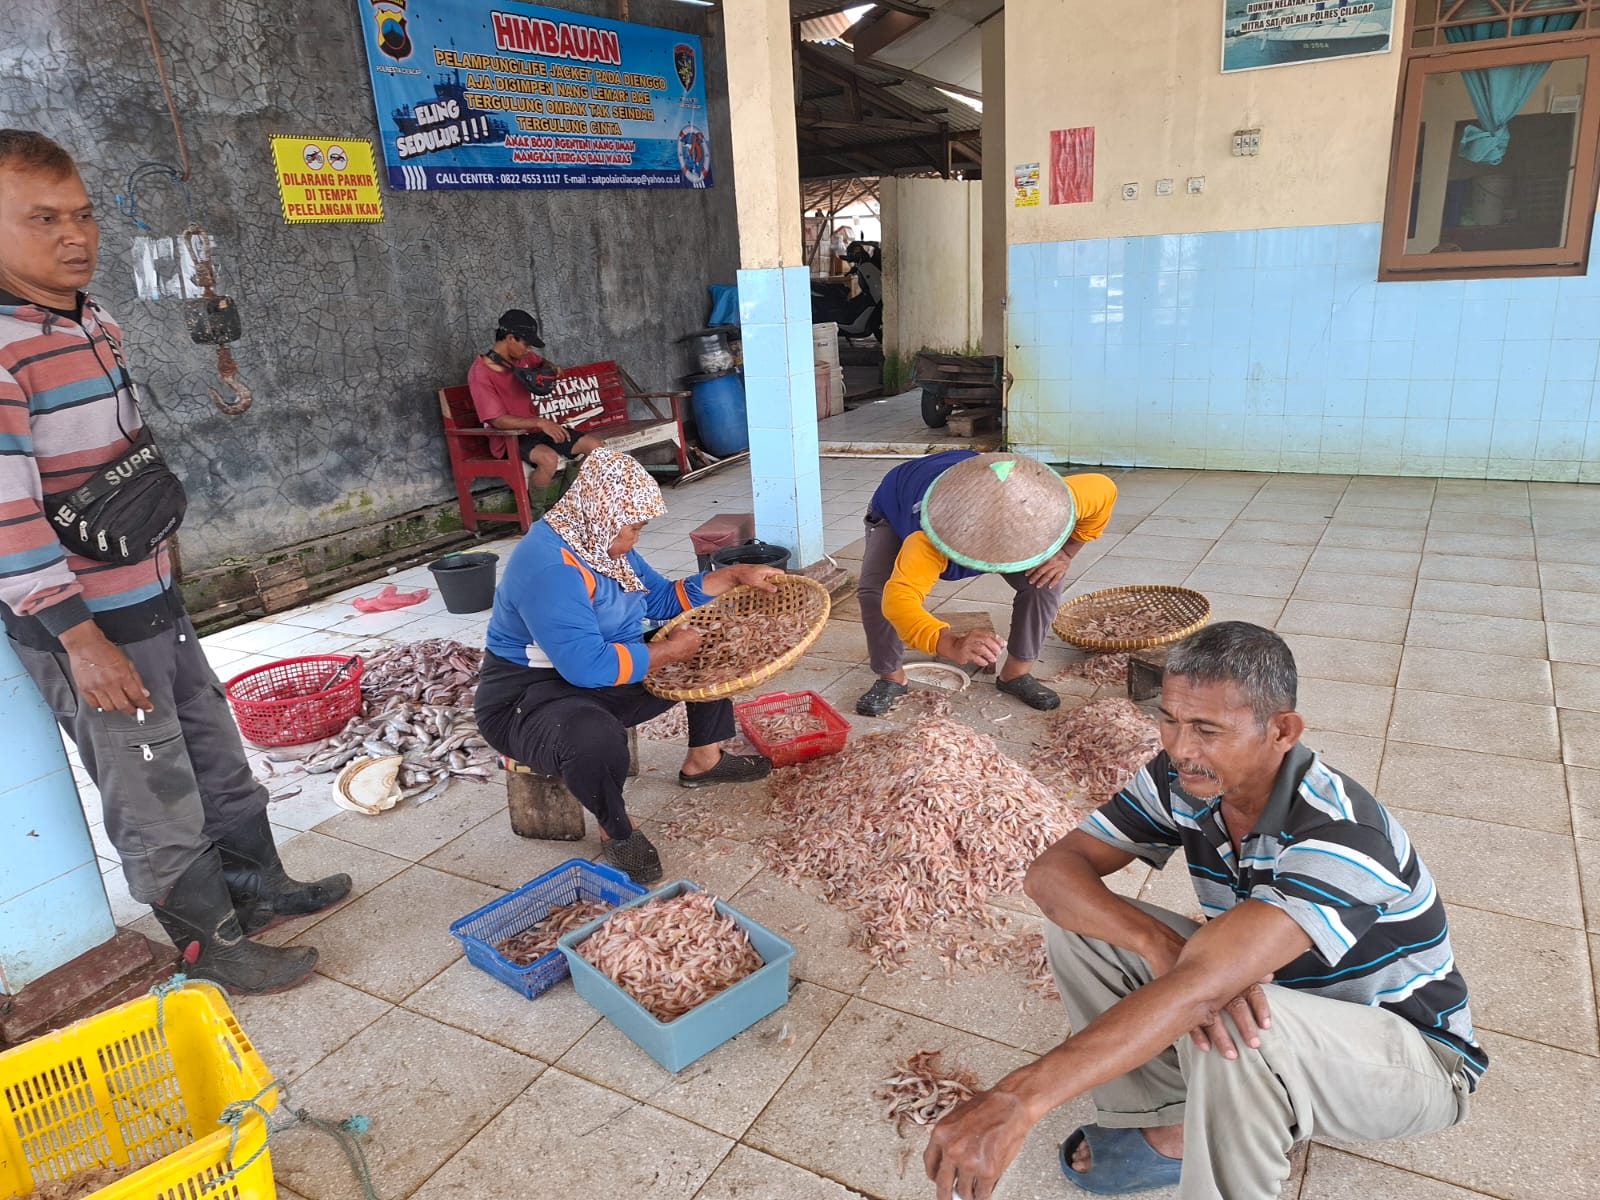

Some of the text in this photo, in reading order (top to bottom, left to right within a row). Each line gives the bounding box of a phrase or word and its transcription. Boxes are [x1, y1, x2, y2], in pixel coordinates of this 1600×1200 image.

[1248, 1, 1273, 13] RUKUN
[1240, 4, 1374, 31] MITRA SAT POL AIR POLRES CILACAP
[491, 11, 621, 65] HIMBAUAN
[550, 64, 592, 82] JACKET
[595, 70, 622, 86] PADA
[624, 74, 667, 90] DIENGGO
[467, 74, 651, 105] AJA DISIMPEN NANG LEMARI BAE
[414, 99, 460, 126] ELING
[464, 92, 655, 121] TERGULUNG OMBAK TAK SEINDAH
[516, 116, 622, 136] TERGULUNG CINTA
[505, 134, 530, 149] ANAK
[532, 135, 553, 149] BOJO
[594, 139, 614, 152] NANG
[283, 173, 373, 187] DILARANG PARKIR
[436, 172, 459, 184] CALL
[461, 173, 495, 185] CENTER
[501, 174, 520, 185] 0822
[522, 174, 541, 185] 4553
[543, 174, 560, 185] 1117
[564, 173, 587, 185] E-mail
[592, 173, 681, 187] satpolaircilacap@yahoo.co.id
[305, 188, 358, 201] DI TEMPAT
[288, 203, 379, 217] PELELANGAN IKAN
